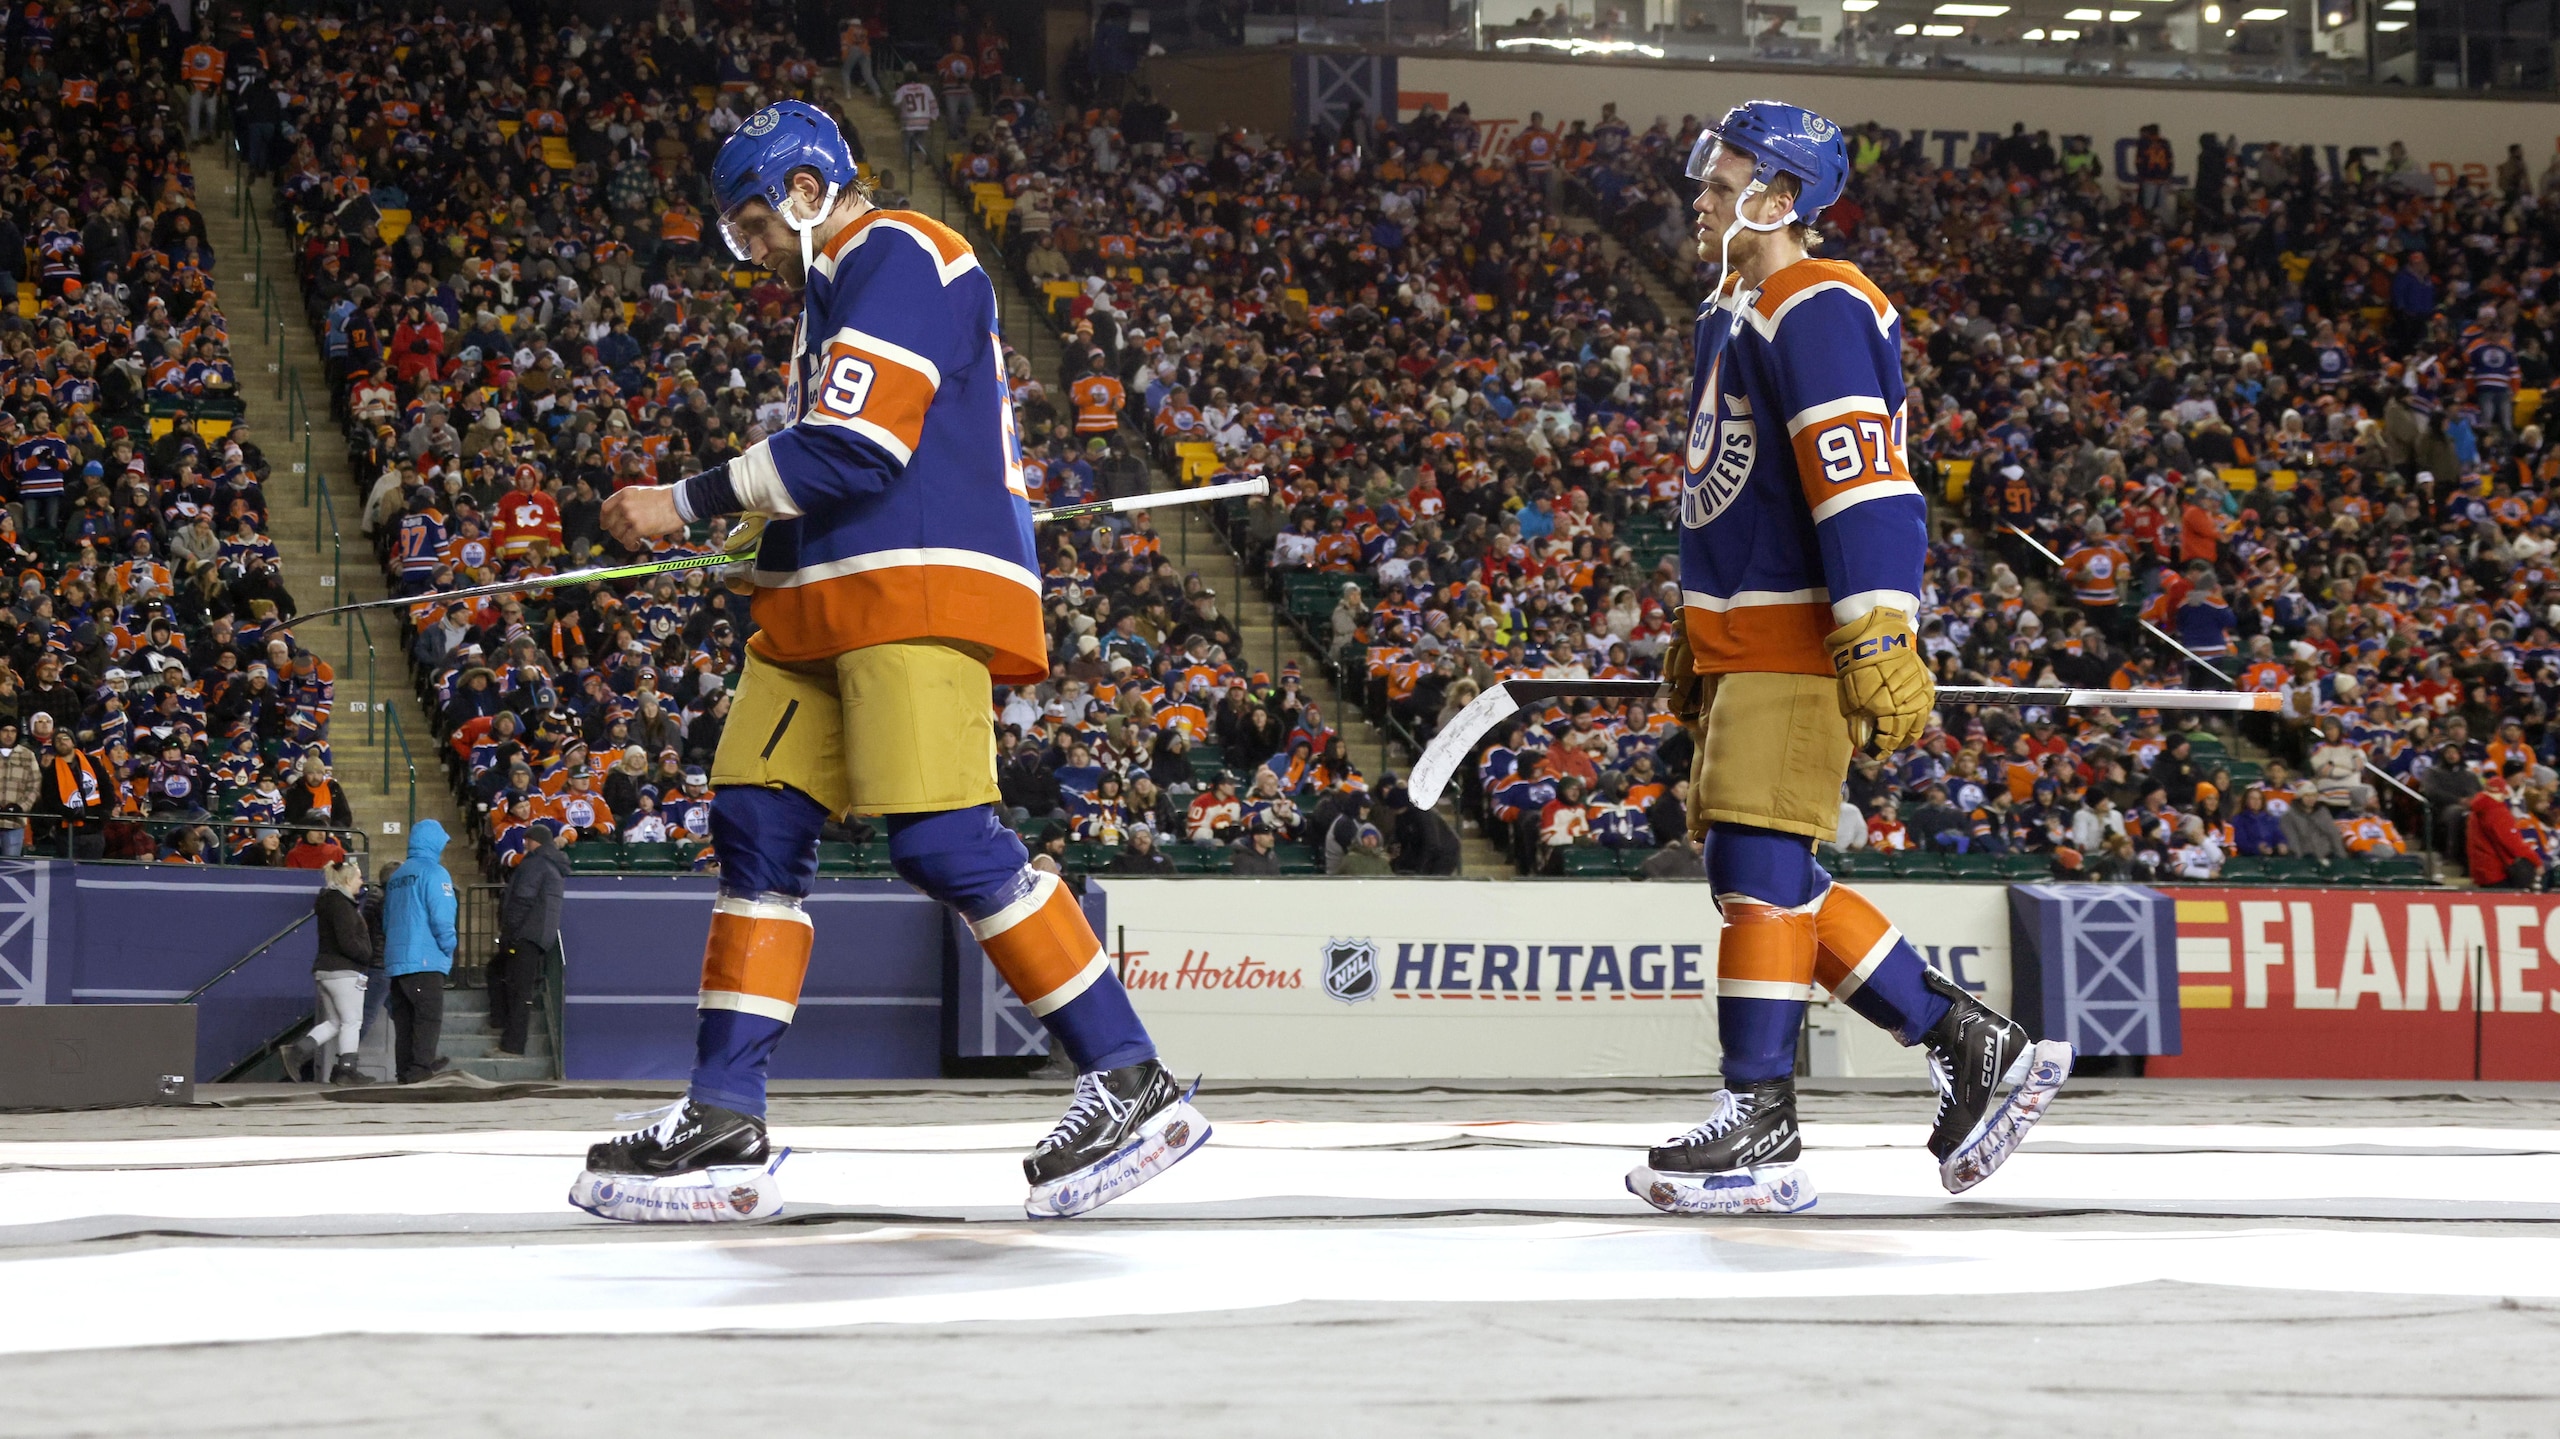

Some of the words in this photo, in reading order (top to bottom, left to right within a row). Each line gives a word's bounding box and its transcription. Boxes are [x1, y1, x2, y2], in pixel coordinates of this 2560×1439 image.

[1691, 412, 1714, 450] 97
[1816, 418, 1892, 485] 97
[1700, 433, 1752, 516] OILERS
[2005, 487, 2032, 513] 97
[1834, 633, 1908, 673] CCM
[353, 703, 365, 712] 10
[388, 823, 395, 832] 5
[1110, 951, 1168, 990] Tim
[1176, 949, 1302, 990] Hortons
[1333, 954, 1369, 991] NHL
[1390, 943, 1704, 991] HERITAGE
[1980, 1034, 1997, 1089] CCM
[661, 1123, 703, 1152] CCM
[1735, 1119, 1789, 1168] CCM
[626, 1194, 690, 1211] DMONTON
[692, 1201, 726, 1211] 2023
[1743, 1195, 1772, 1207] 2023
